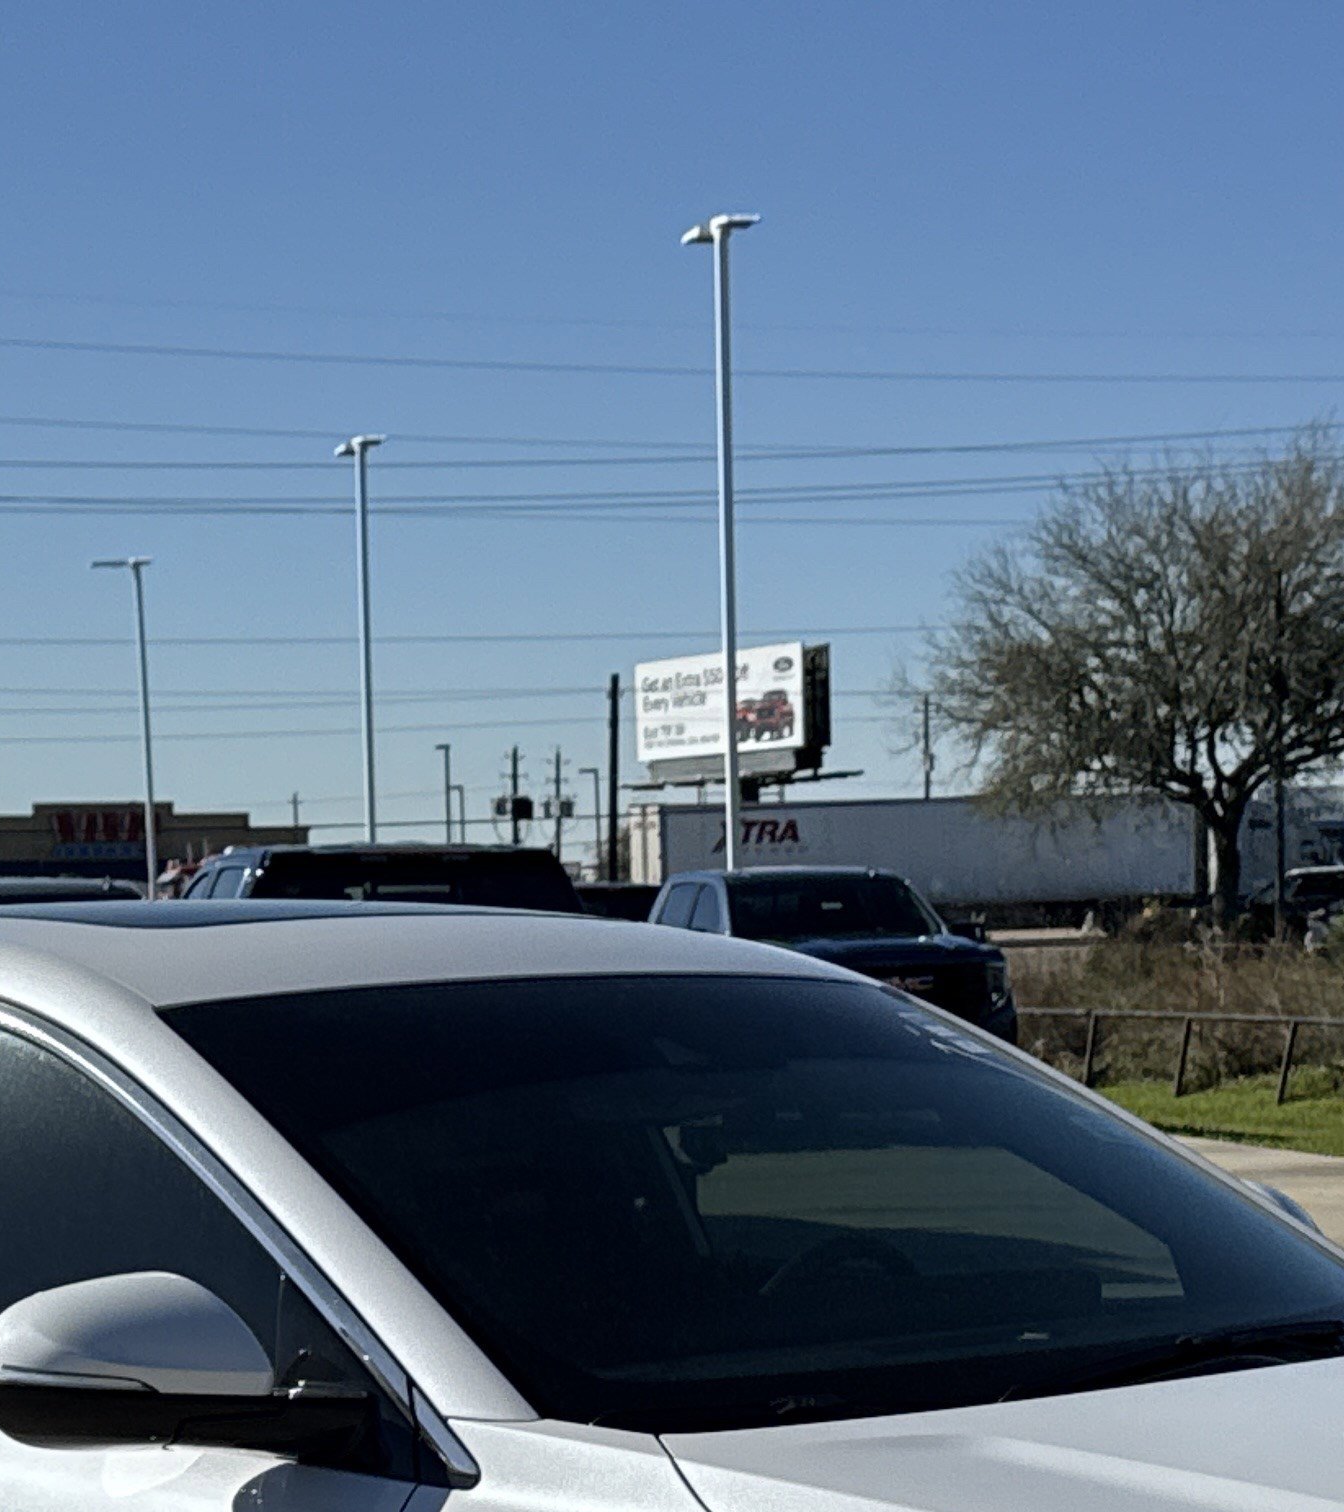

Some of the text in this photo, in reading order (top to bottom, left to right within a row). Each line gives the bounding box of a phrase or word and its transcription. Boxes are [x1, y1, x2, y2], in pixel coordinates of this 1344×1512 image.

[641, 676, 659, 692] Get
[674, 672, 701, 689] Extra
[642, 695, 669, 714] Every
